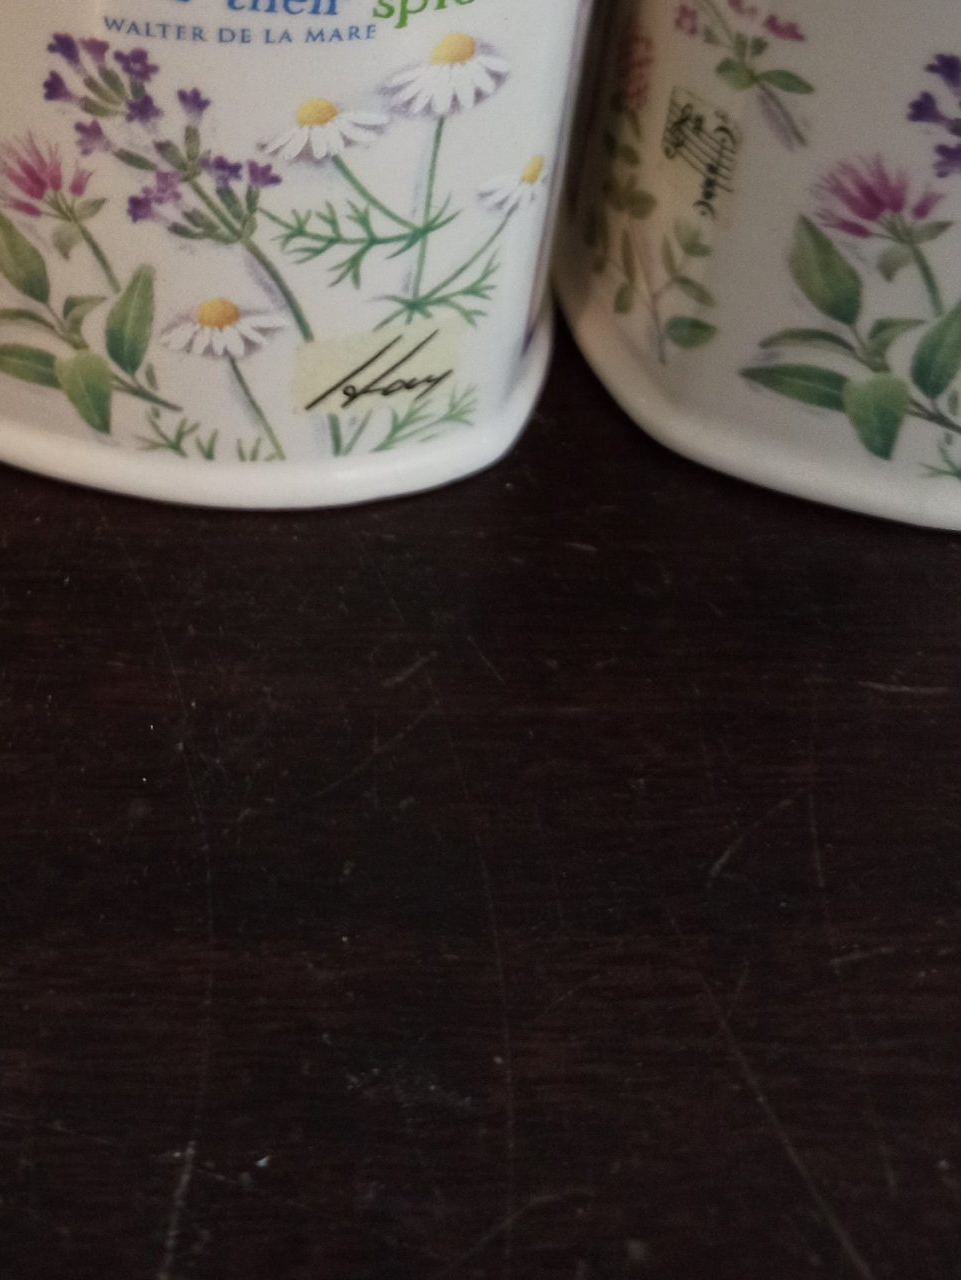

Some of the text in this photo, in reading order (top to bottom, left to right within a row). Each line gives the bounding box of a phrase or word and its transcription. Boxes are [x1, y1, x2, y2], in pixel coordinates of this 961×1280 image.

[104, 16, 377, 45] WALTER DE LA MARE
